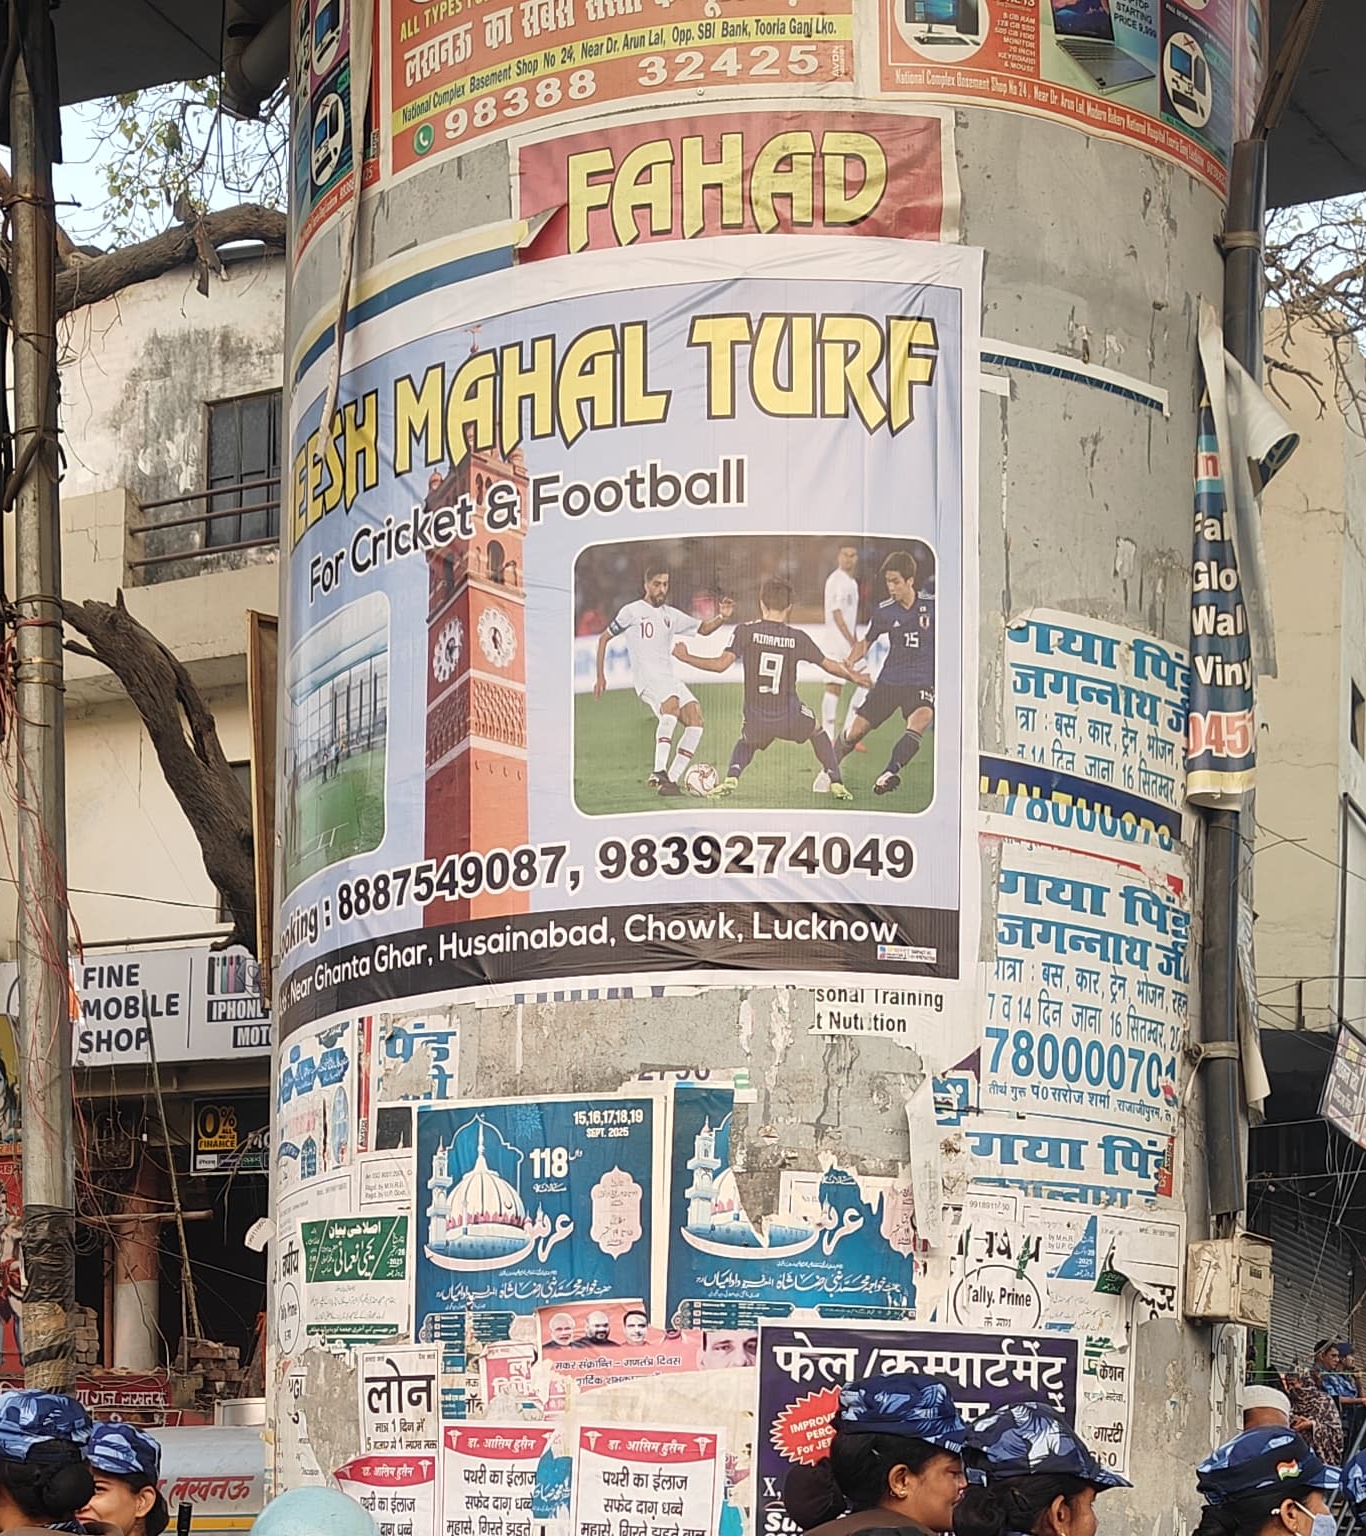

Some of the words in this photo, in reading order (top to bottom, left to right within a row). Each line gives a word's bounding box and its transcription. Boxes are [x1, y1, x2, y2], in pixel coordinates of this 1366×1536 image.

[400, 20, 420, 42] ALL
[404, 22, 473, 88] लखनऊ
[483, 7, 514, 49] का
[402, 94, 431, 124] National
[433, 84, 465, 111] Complex
[469, 67, 511, 94] Basement
[515, 58, 539, 77] Shop
[543, 52, 556, 68] No
[581, 40, 605, 59] Near
[606, 37, 620, 54] Dr.
[622, 33, 646, 51] Arun
[672, 26, 695, 45] Opp.
[698, 24, 716, 40] SBI
[721, 21, 751, 38] Bank,
[815, 16, 837, 35] Lko.
[895, 69, 925, 84] National
[926, 71, 955, 88] Complex
[444, 69, 596, 139] 98388
[637, 45, 819, 87] 32425
[568, 131, 888, 254] FAHAD
[290, 389, 379, 552] EESH
[394, 321, 672, 476] MAHAL
[688, 313, 939, 436] TURF
[309, 535, 345, 604] For
[350, 496, 475, 576] Cricket
[486, 484, 519, 532] &
[531, 457, 747, 524] Football
[639, 621, 654, 640] 10
[1006, 620, 1122, 671] गया
[757, 651, 785, 694] 9
[597, 834, 916, 881] 9839274049
[998, 868, 1111, 917] गया
[315, 956, 371, 991] Ghanta
[375, 944, 434, 973] Ghar,
[439, 913, 618, 964] Husainabad,
[625, 911, 746, 945] Chowk,
[752, 912, 899, 944] Lucknow
[83, 963, 142, 991] FINE
[81, 993, 181, 1021] MOBILE
[1018, 996, 1033, 1024] 14
[1037, 989, 1064, 1029] दिन
[1071, 1003, 1102, 1033] जाना
[1110, 1012, 1123, 1040] 16
[79, 1028, 151, 1055] SHOP
[198, 1104, 238, 1140] 0%
[573, 1109, 644, 1125] 15,16,17,18,19
[586, 1127, 606, 1138] SEPT.
[608, 1126, 629, 1137] 2025
[198, 1139, 237, 1149] FINANCE
[965, 1132, 1089, 1170] गया
[529, 1147, 569, 1178] 118
[773, 1331, 860, 1384] फेल
[365, 1357, 436, 1415] लोन
[399, 1418, 415, 1433] दिन
[169, 1475, 255, 1508] लखनऊ
[464, 1463, 487, 1486] पथरी
[489, 1470, 503, 1486] का
[603, 1466, 629, 1488] पथरी
[633, 1472, 649, 1489] का
[603, 1493, 633, 1514] सफेद
